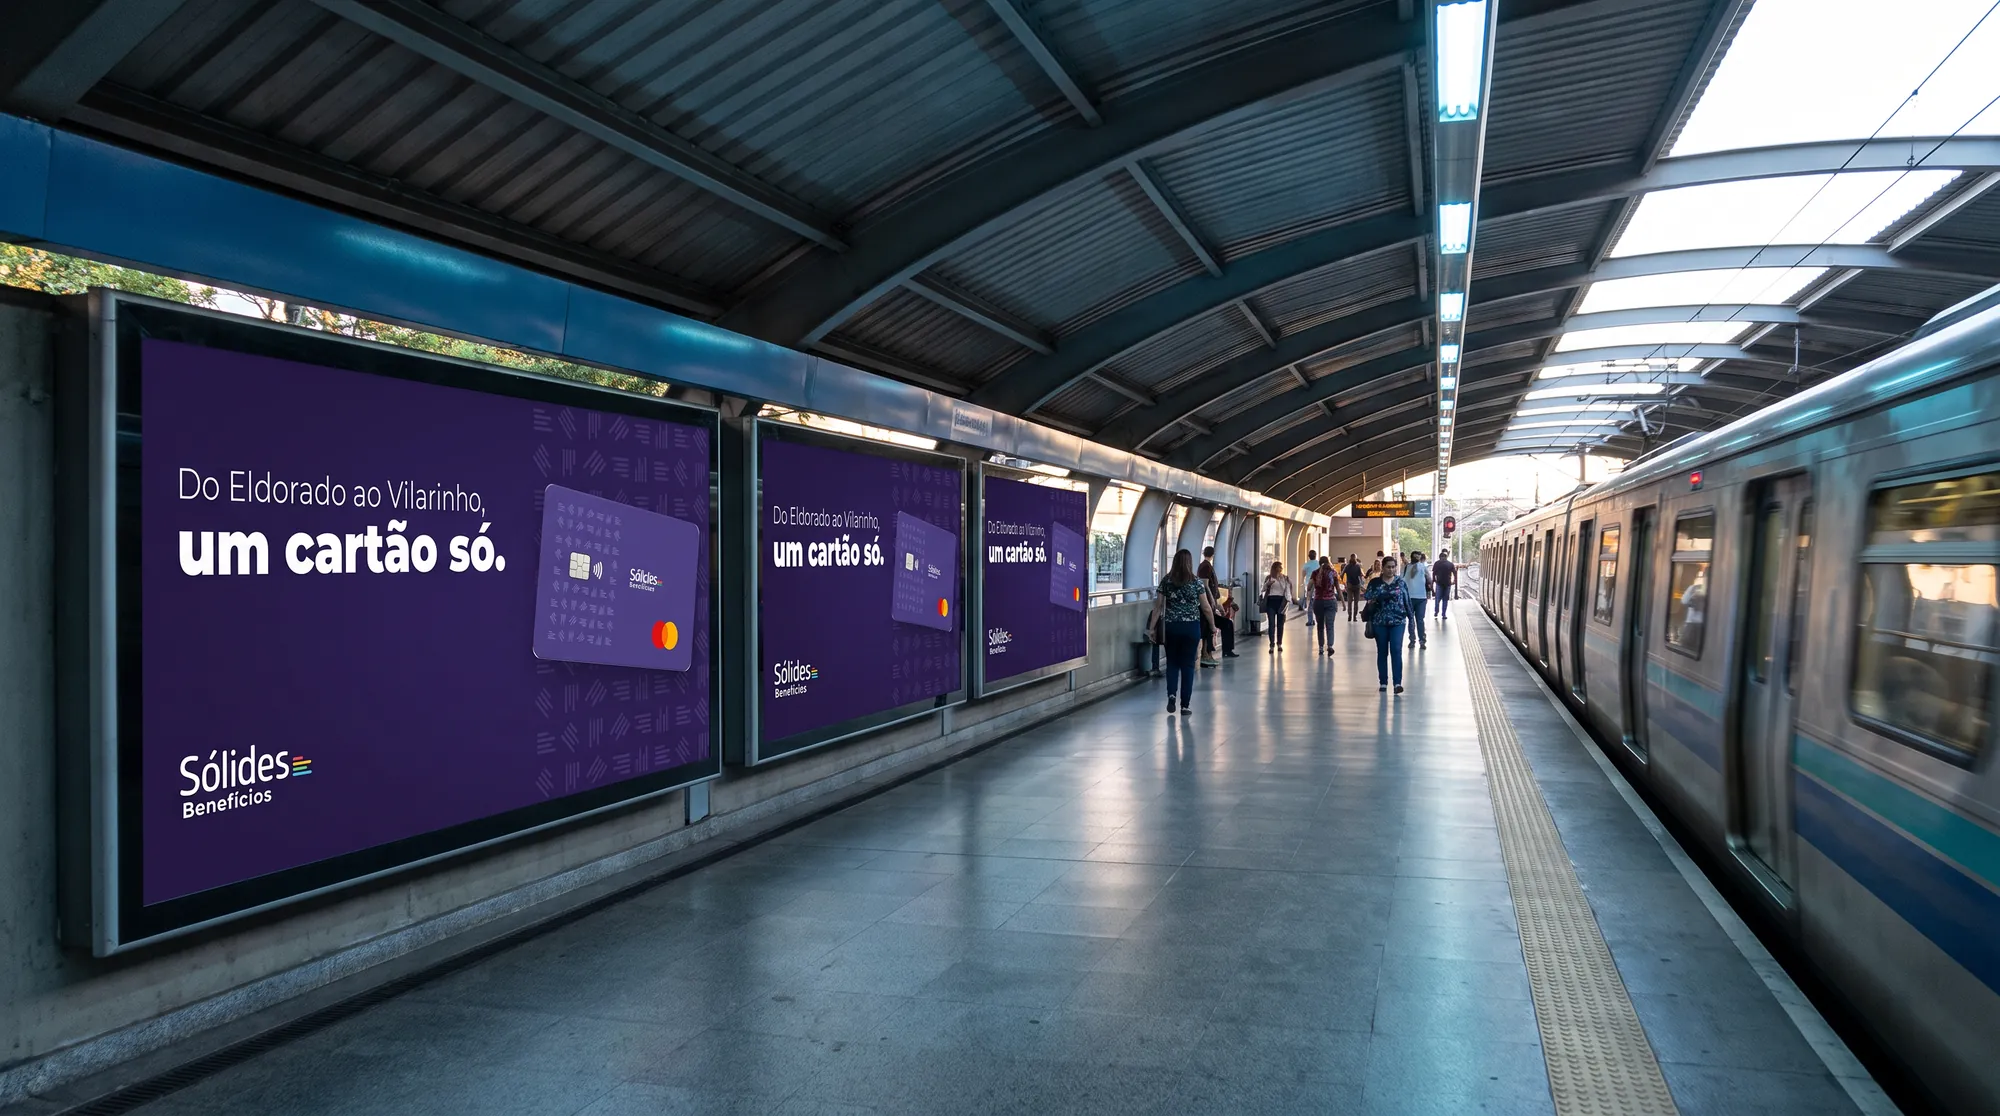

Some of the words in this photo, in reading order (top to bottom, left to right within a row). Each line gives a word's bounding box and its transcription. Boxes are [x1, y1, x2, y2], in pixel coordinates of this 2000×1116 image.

[179, 467, 220, 501] Do
[230, 470, 346, 506] Eldorado
[353, 485, 382, 508] ao
[387, 479, 486, 518] Vilarinho,
[773, 505, 788, 525] Do
[790, 506, 831, 527] Eldorado
[831, 514, 843, 528] ao
[843, 510, 880, 532] Vilarinho,
[178, 530, 269, 576] um
[285, 518, 438, 575] cartão
[449, 521, 506, 573] só.
[773, 541, 803, 568] um
[808, 533, 860, 567] cartão
[863, 535, 885, 566] só.
[988, 545, 1004, 563] um
[1005, 540, 1034, 563] cartão
[1035, 540, 1047, 563] só.
[773, 659, 811, 686] Sólides
[179, 744, 291, 797] Sólides
[182, 788, 273, 819] Benefícios
